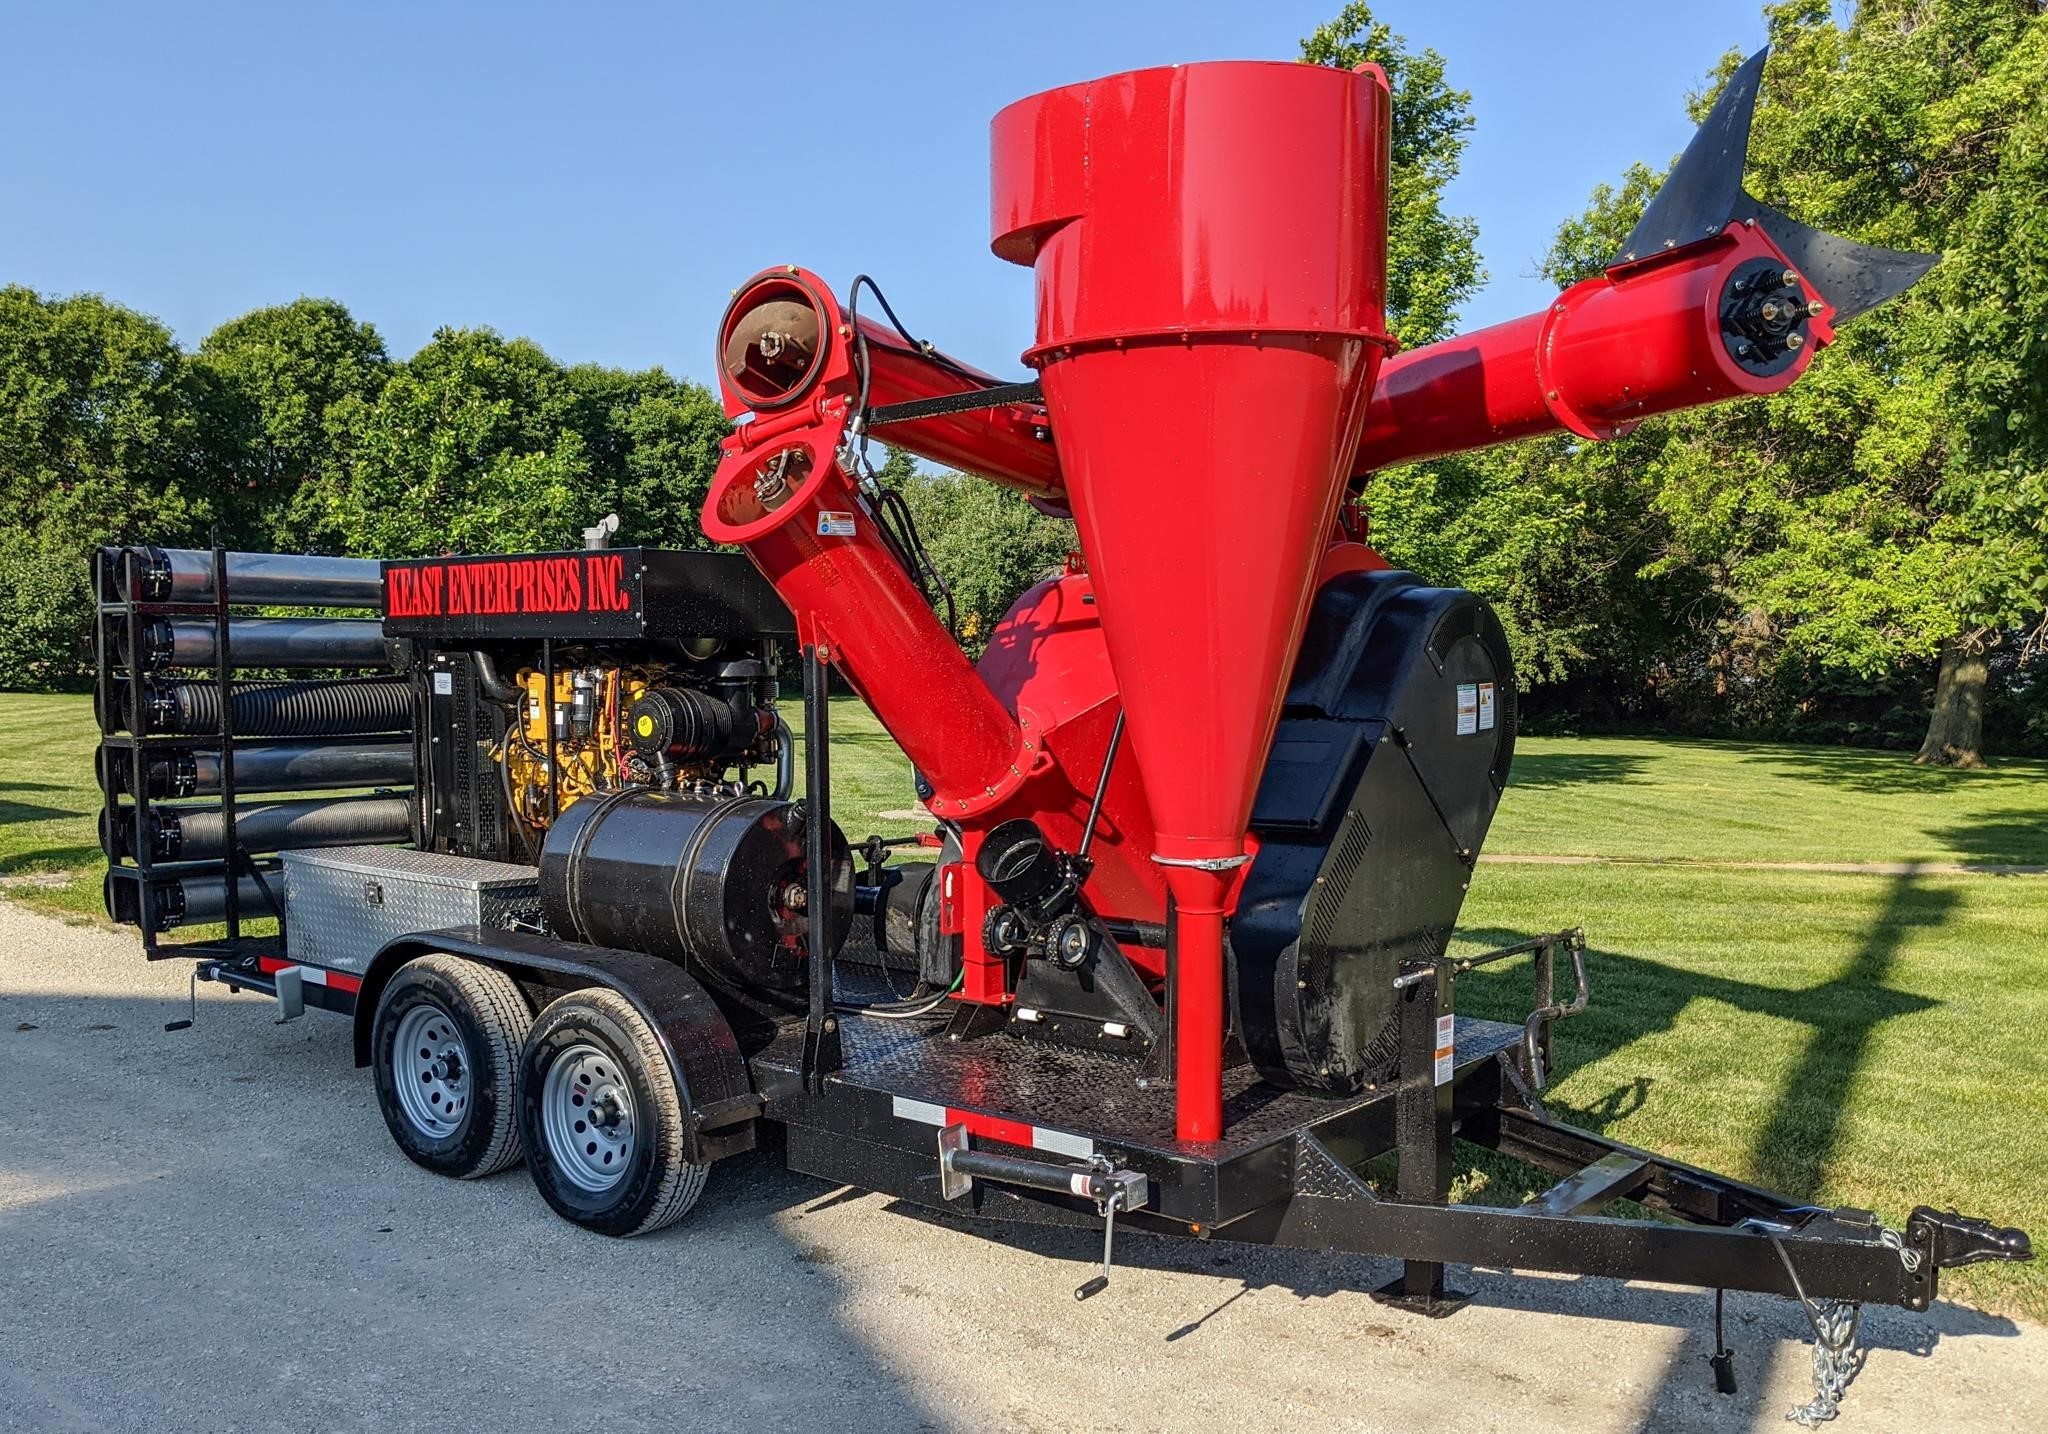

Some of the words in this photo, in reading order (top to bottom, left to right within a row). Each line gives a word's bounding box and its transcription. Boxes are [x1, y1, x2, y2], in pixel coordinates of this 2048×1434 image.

[387, 566, 443, 617] KEAST
[447, 557, 582, 615] ENTERPRISES
[586, 554, 630, 612] INC.
